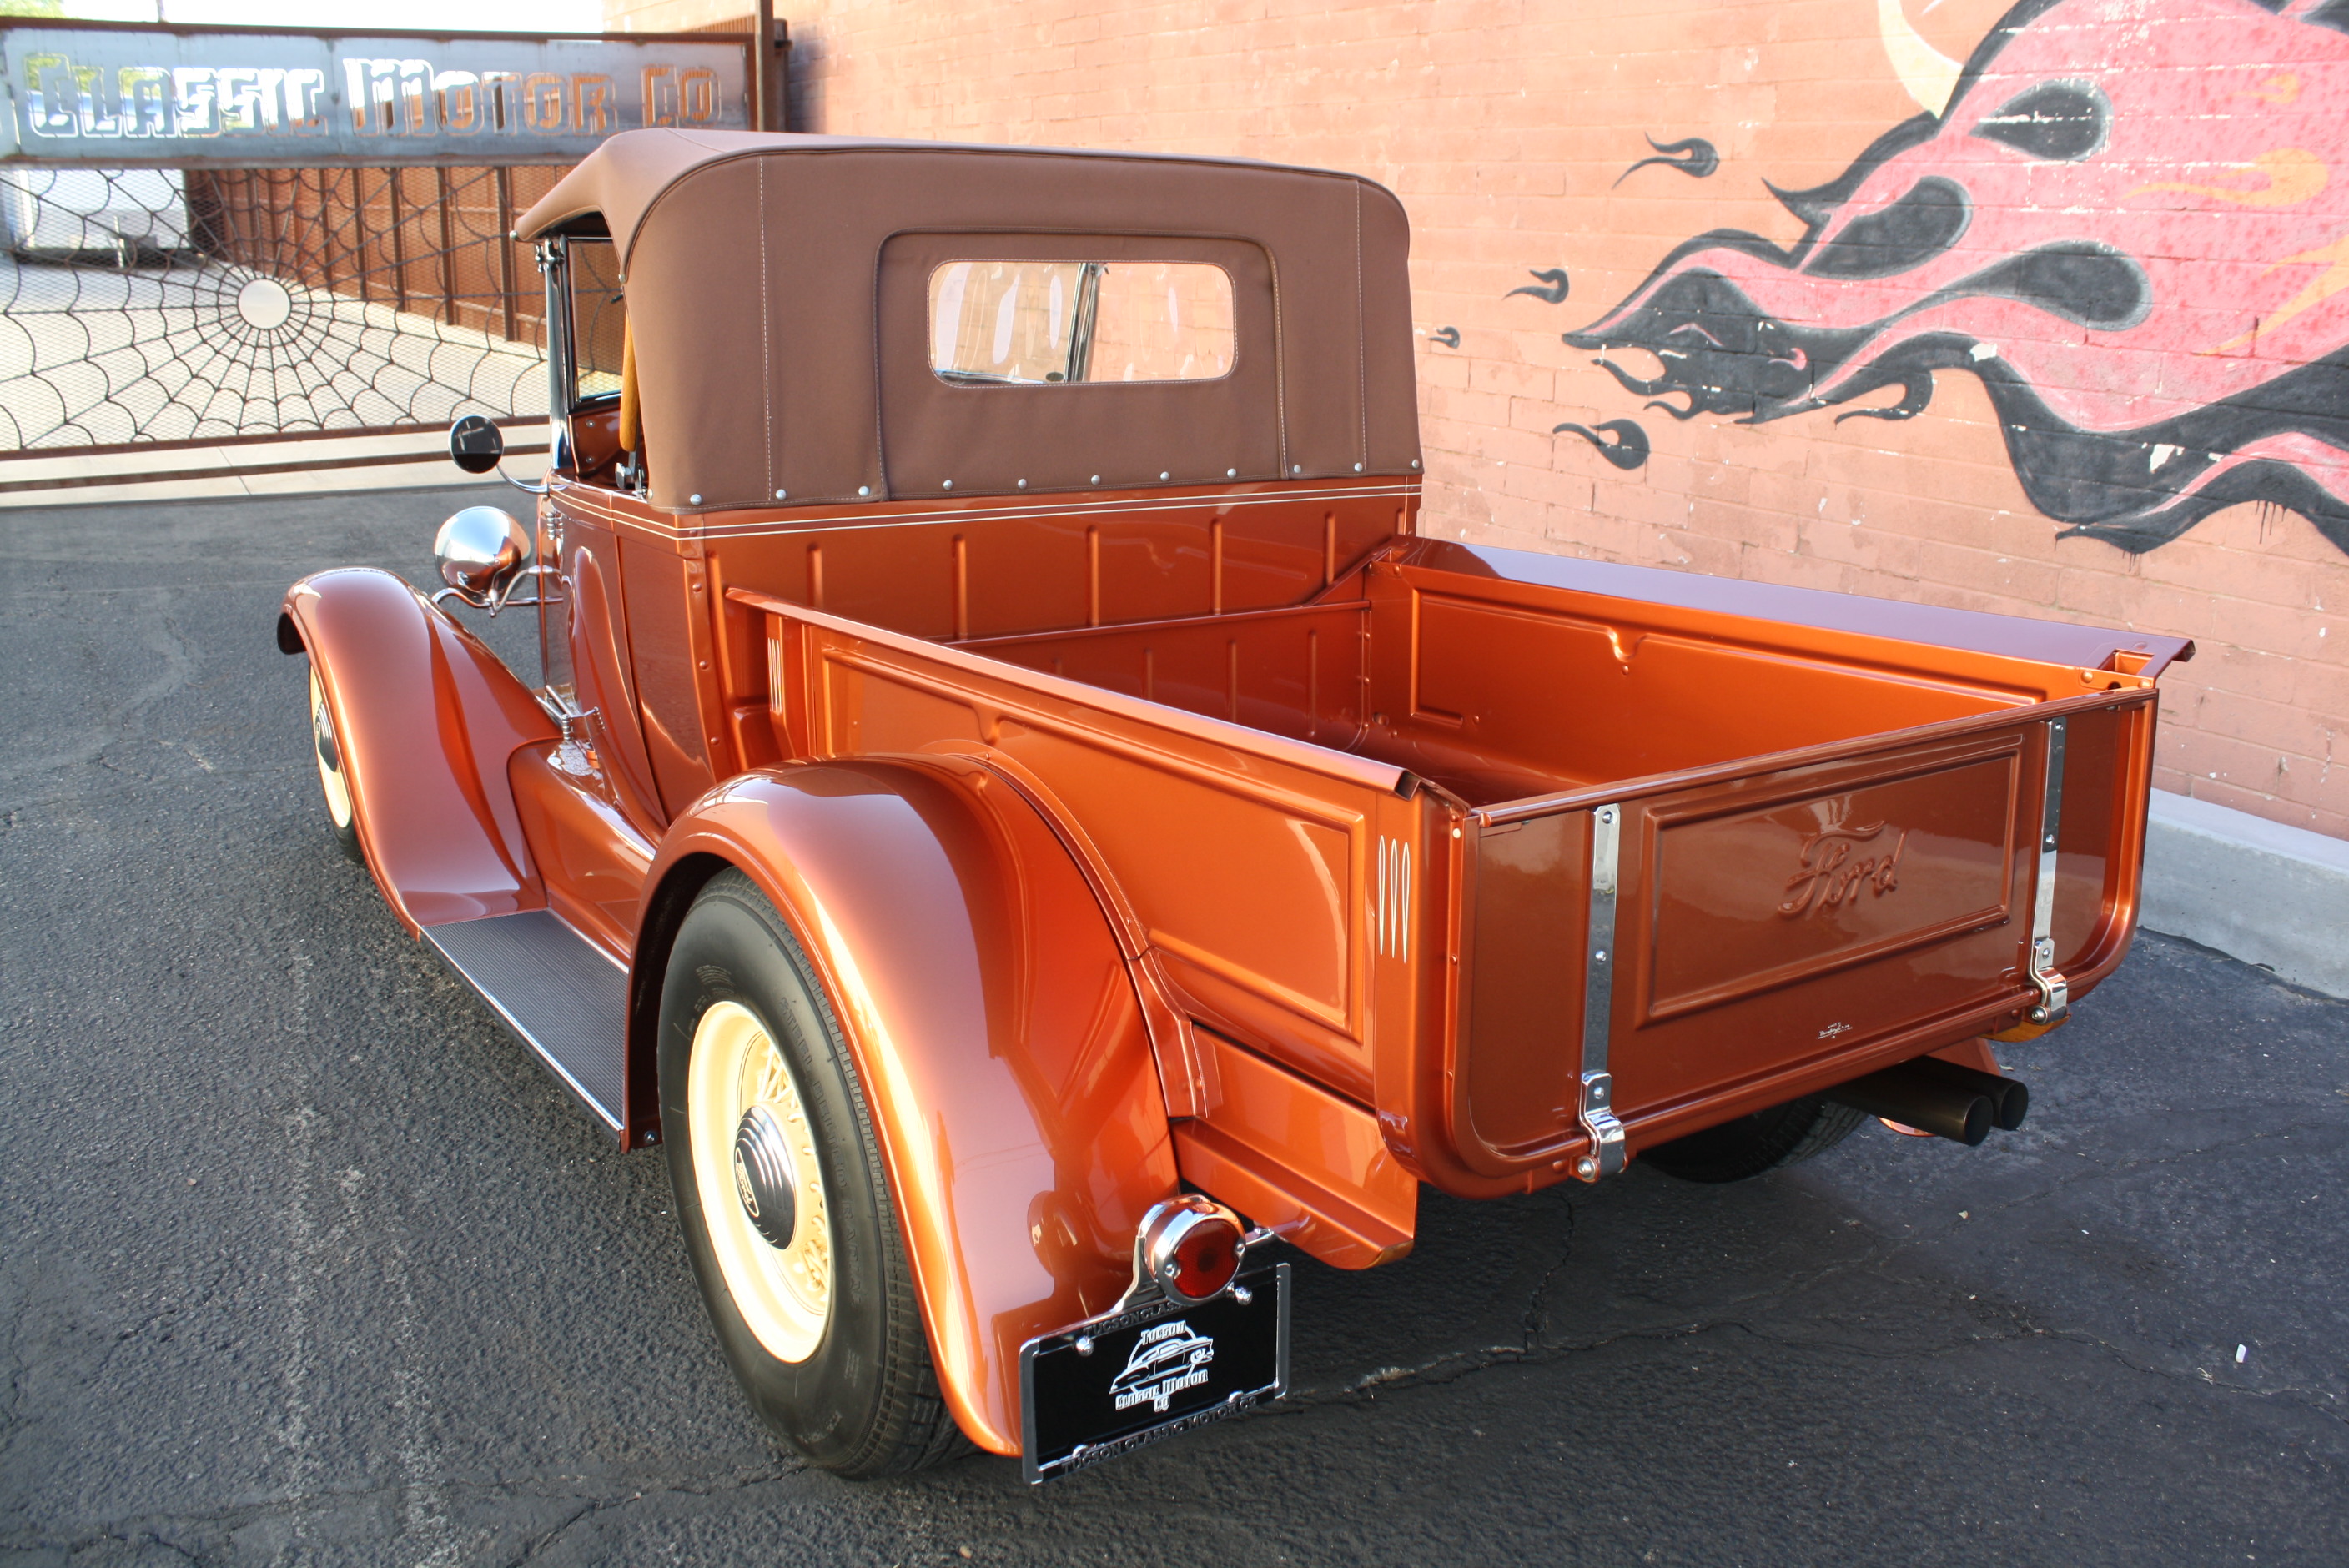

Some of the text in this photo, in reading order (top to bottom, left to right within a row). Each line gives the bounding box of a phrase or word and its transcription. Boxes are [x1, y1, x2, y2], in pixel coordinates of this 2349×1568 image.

[24, 53, 329, 138] CLASSIC
[343, 58, 619, 137] MOTOR
[1777, 820, 1907, 919] Ford
[1141, 1320, 1186, 1345] TUCSON
[1115, 1369, 1209, 1410] CLASSIC MOTOR
[1061, 1443, 1121, 1474] TUCSON
[1125, 1422, 1184, 1450] CLASSIC
[1187, 1403, 1237, 1429] MOTOR
